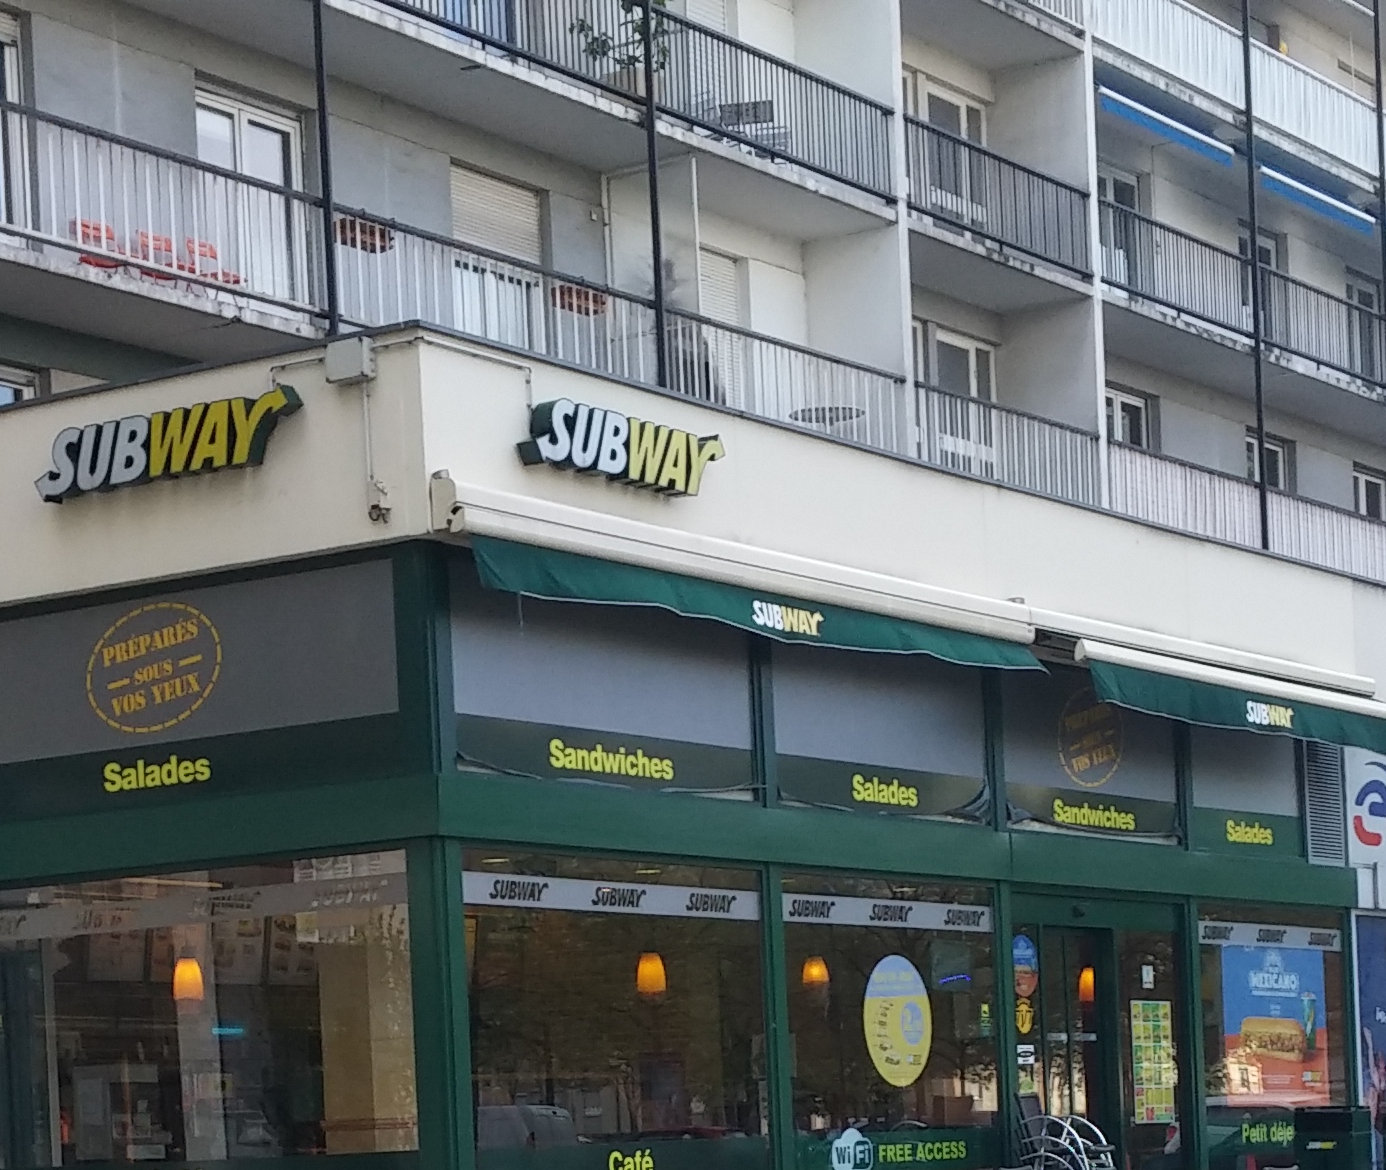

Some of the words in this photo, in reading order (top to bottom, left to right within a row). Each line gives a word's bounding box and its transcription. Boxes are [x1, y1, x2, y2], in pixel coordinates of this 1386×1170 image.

[34, 384, 291, 500] SUBWAY
[534, 397, 726, 497] SUBWAY
[752, 600, 824, 636] SUBWAY
[102, 619, 200, 667] PRÉPARÉS
[134, 659, 173, 685] SOUS
[112, 691, 147, 717] VOS
[152, 672, 201, 705] YEUX
[1246, 701, 1295, 728] SUBWAY
[103, 755, 211, 792] Salades
[549, 739, 674, 781] Sandwiches
[852, 774, 918, 807] Salades
[1053, 799, 1135, 830] Sandwiches
[1226, 820, 1273, 845] Salades
[489, 880, 549, 902] SUBWAY
[591, 887, 647, 909] SUBWAY
[686, 893, 737, 914] SUBWAY
[789, 899, 835, 919] SUBWAY
[869, 904, 914, 923] SUBWAY
[944, 909, 986, 928] SUBWAY
[1250, 972, 1299, 991] MEXICANO
[1242, 1123, 1268, 1143] Petit
[878, 1143, 913, 1163] FREE
[916, 1140, 967, 1161] ACCESS
